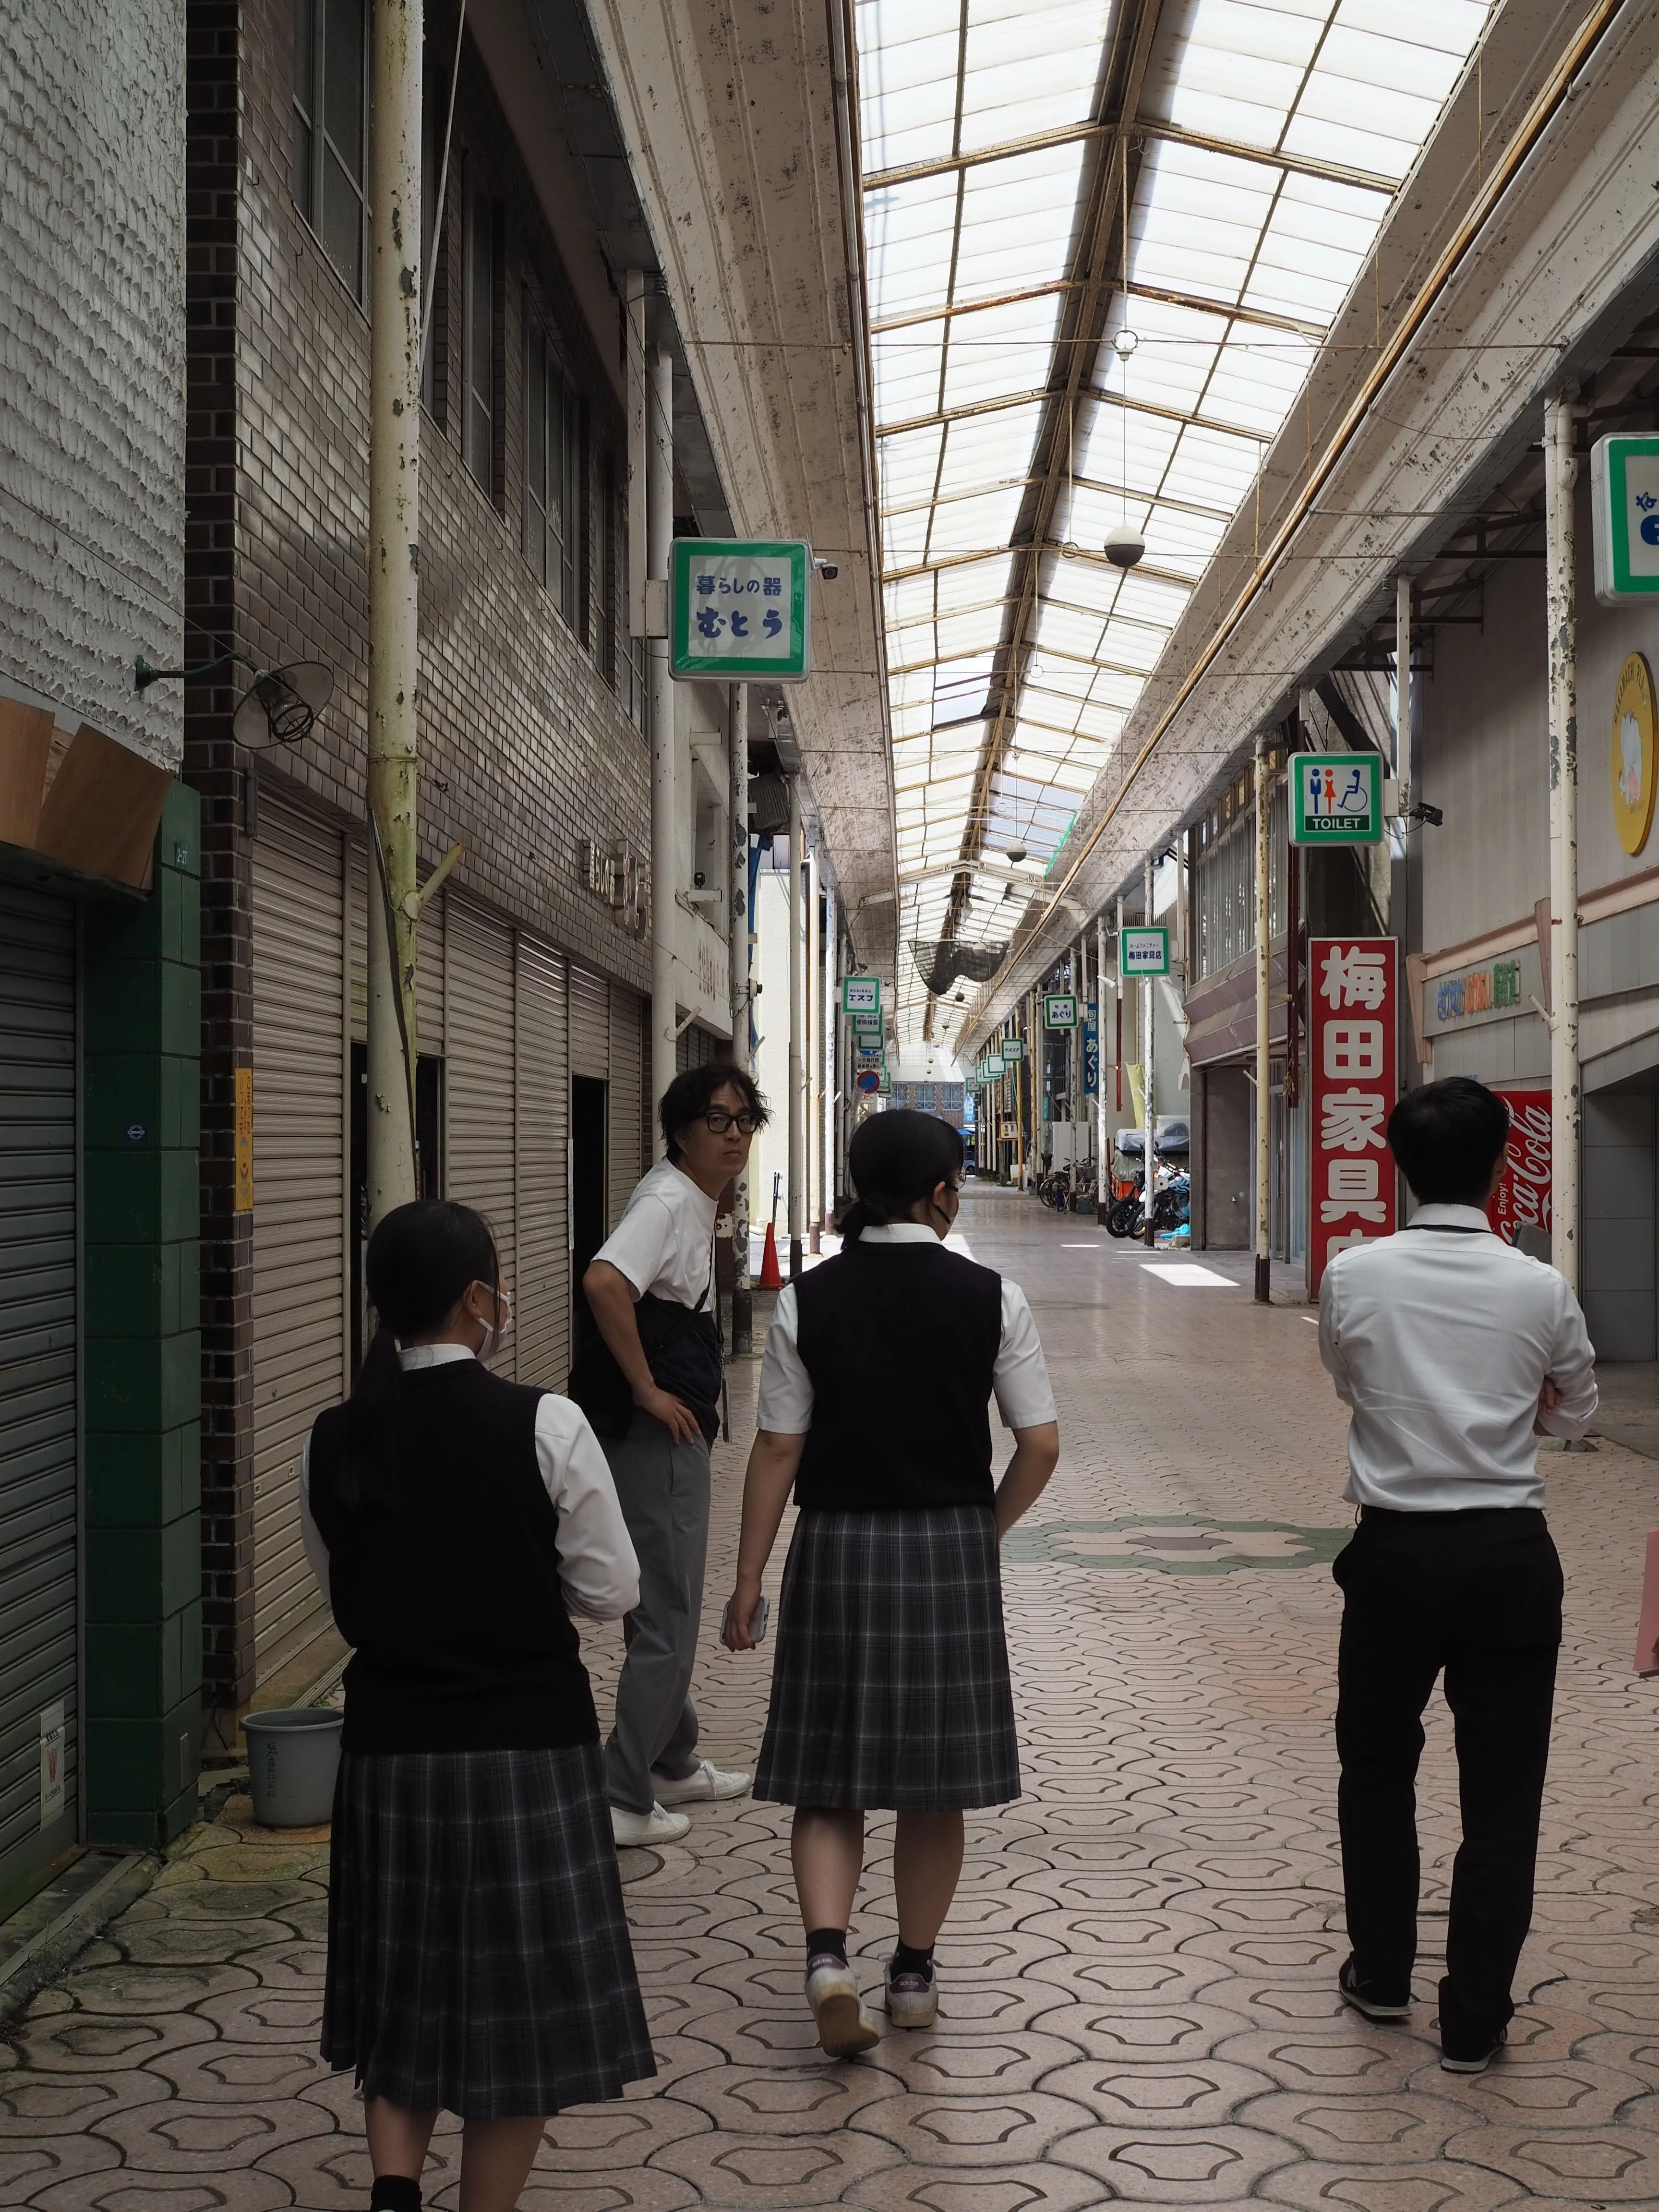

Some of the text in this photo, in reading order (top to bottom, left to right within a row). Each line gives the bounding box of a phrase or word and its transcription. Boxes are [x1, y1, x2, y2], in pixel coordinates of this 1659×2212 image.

[697, 576, 781, 596] 暮らしの器
[697, 606, 782, 639] むとう
[1312, 818, 1360, 830] TOILET
[1129, 950, 1162, 960] 梅田家具店
[1086, 1038, 1098, 1087] あぐり
[1498, 1183, 1508, 1215] Enjoy!
